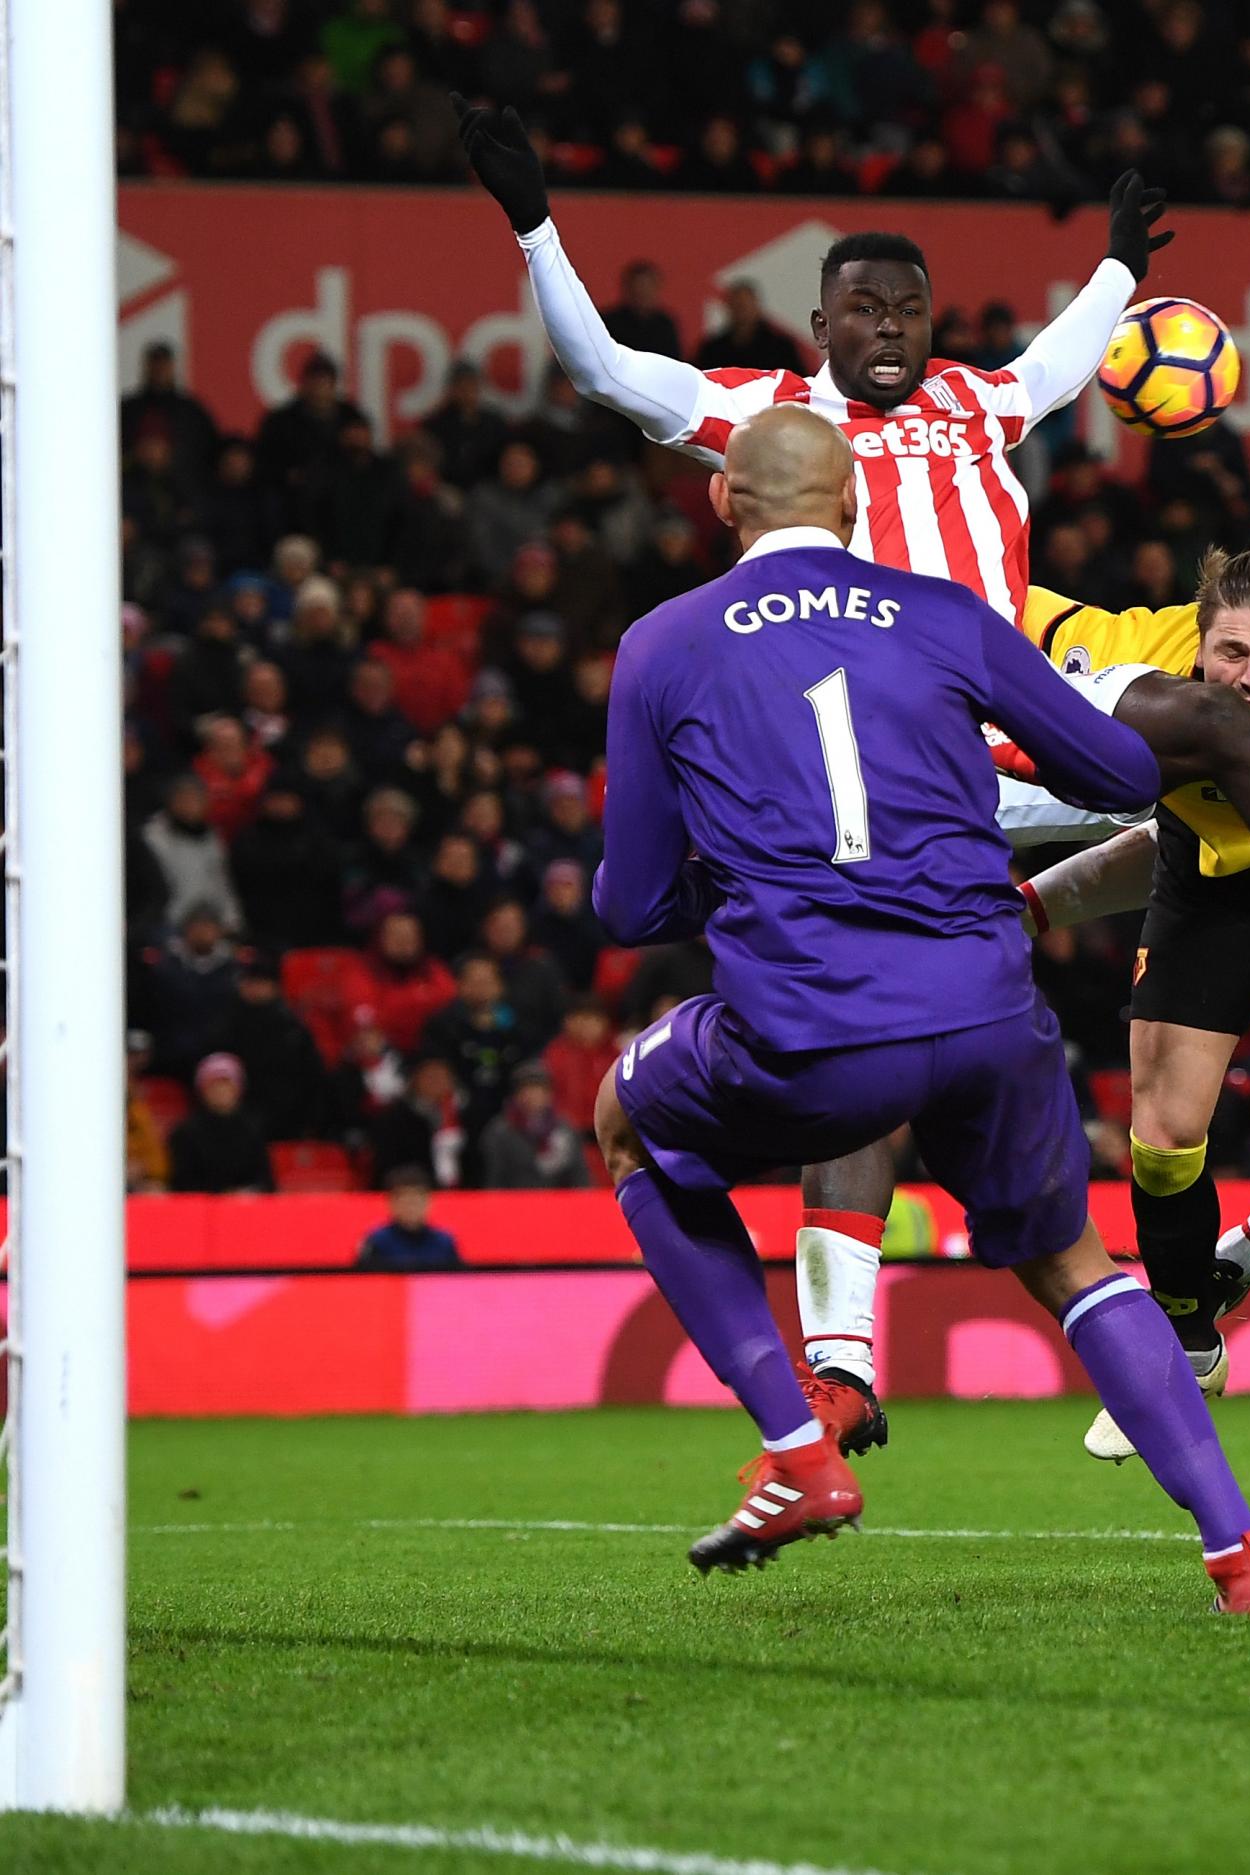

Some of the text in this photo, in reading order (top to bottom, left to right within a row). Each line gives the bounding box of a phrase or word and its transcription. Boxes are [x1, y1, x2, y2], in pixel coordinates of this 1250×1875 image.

[851, 417, 973, 458] et365
[723, 586, 901, 634] GOMES
[803, 667, 871, 864] 1
